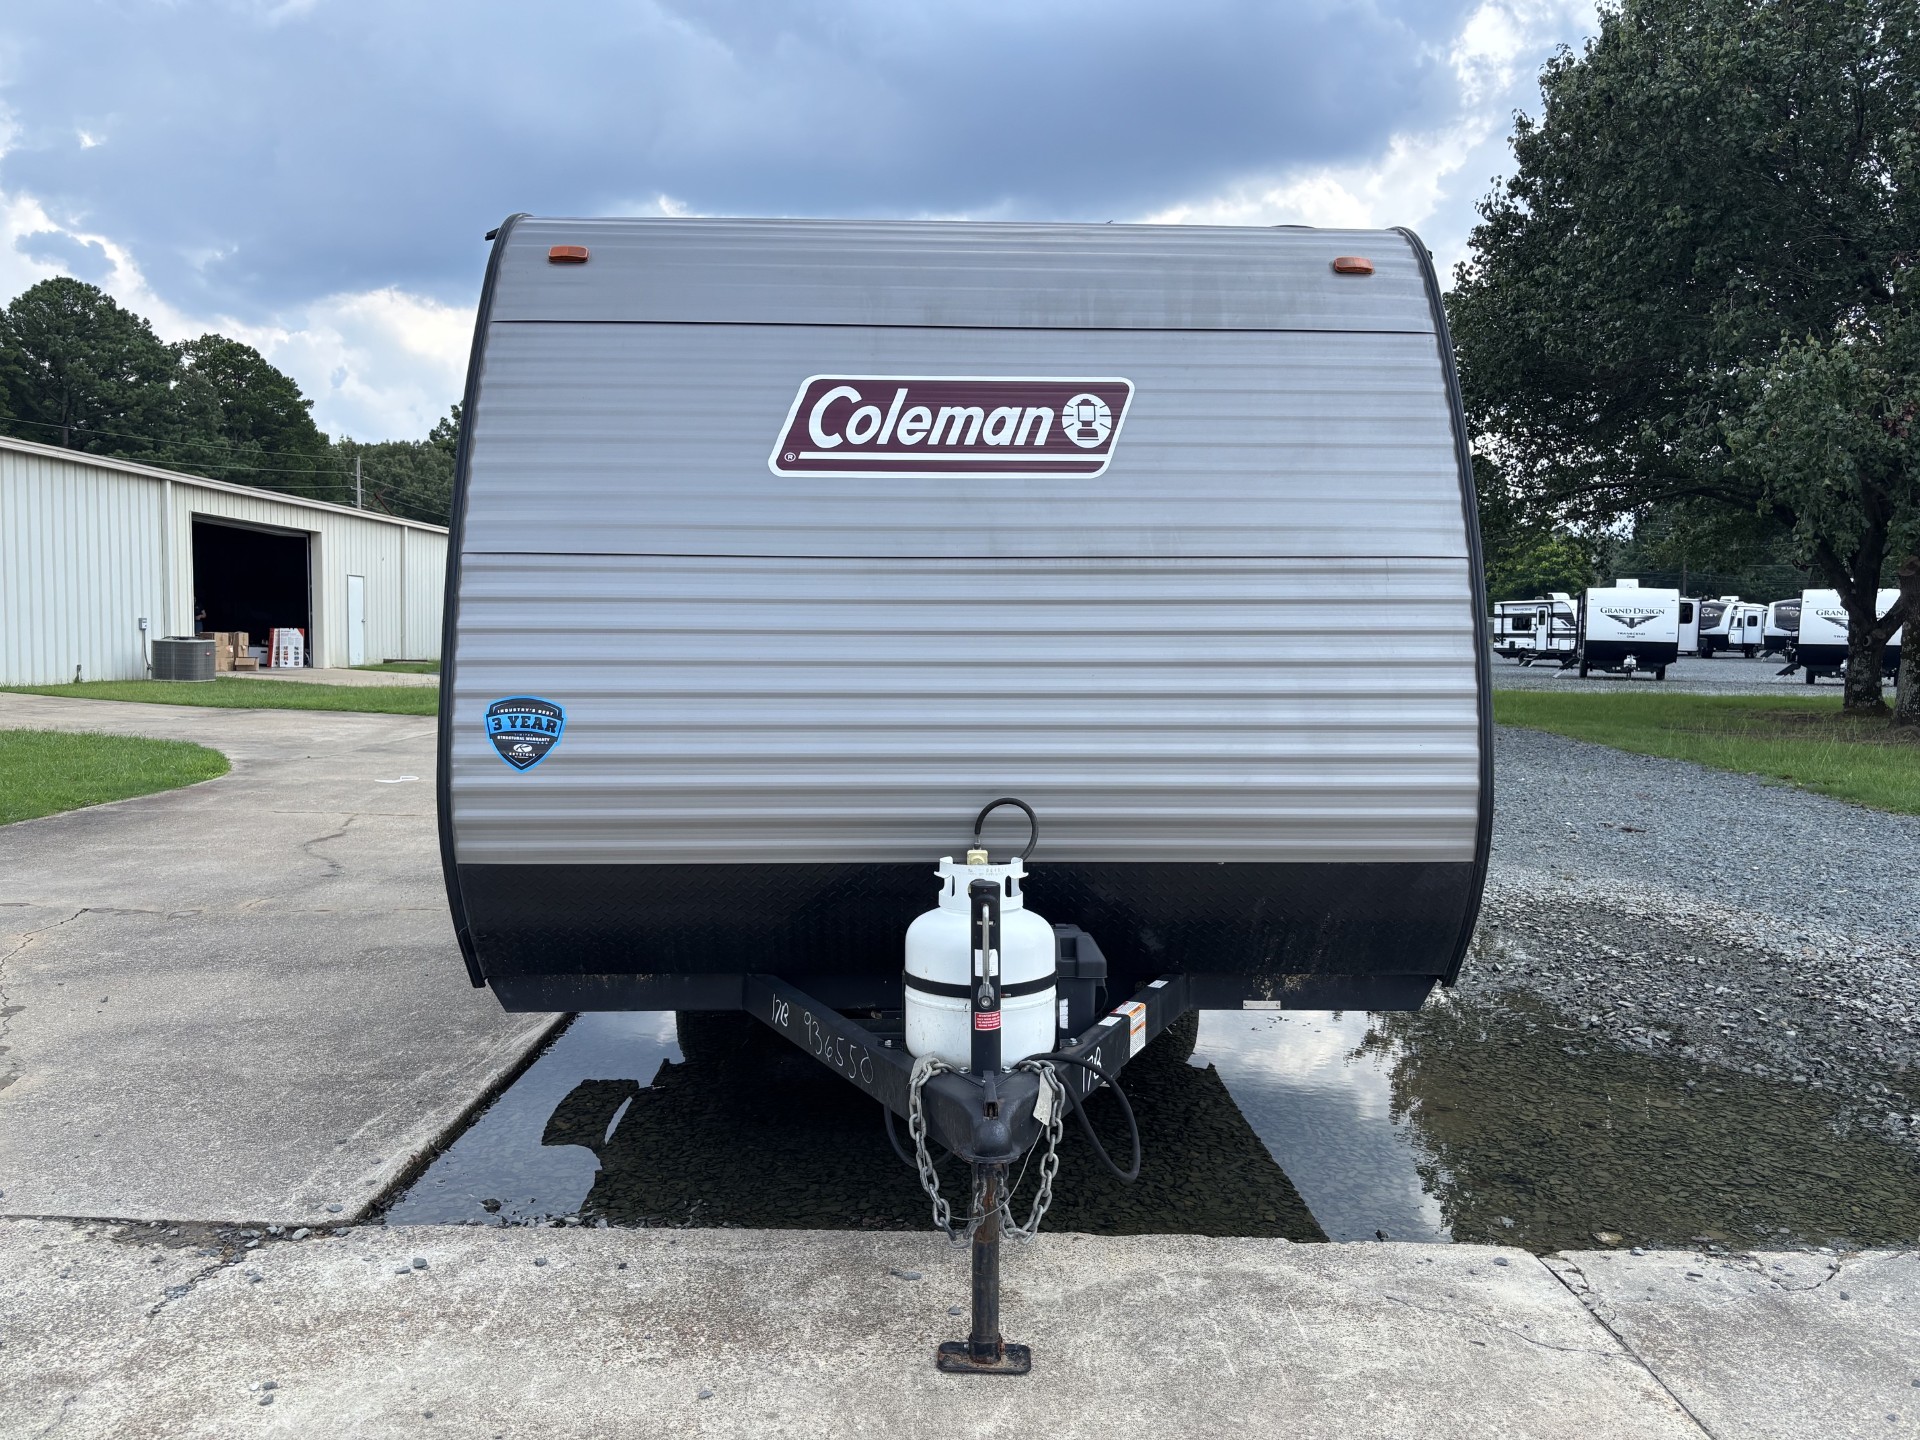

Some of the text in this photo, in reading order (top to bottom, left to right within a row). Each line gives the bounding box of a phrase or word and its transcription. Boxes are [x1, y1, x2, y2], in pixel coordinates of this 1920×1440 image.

[808, 386, 1055, 449] Coleman
[491, 715, 558, 734] 3 YEAR
